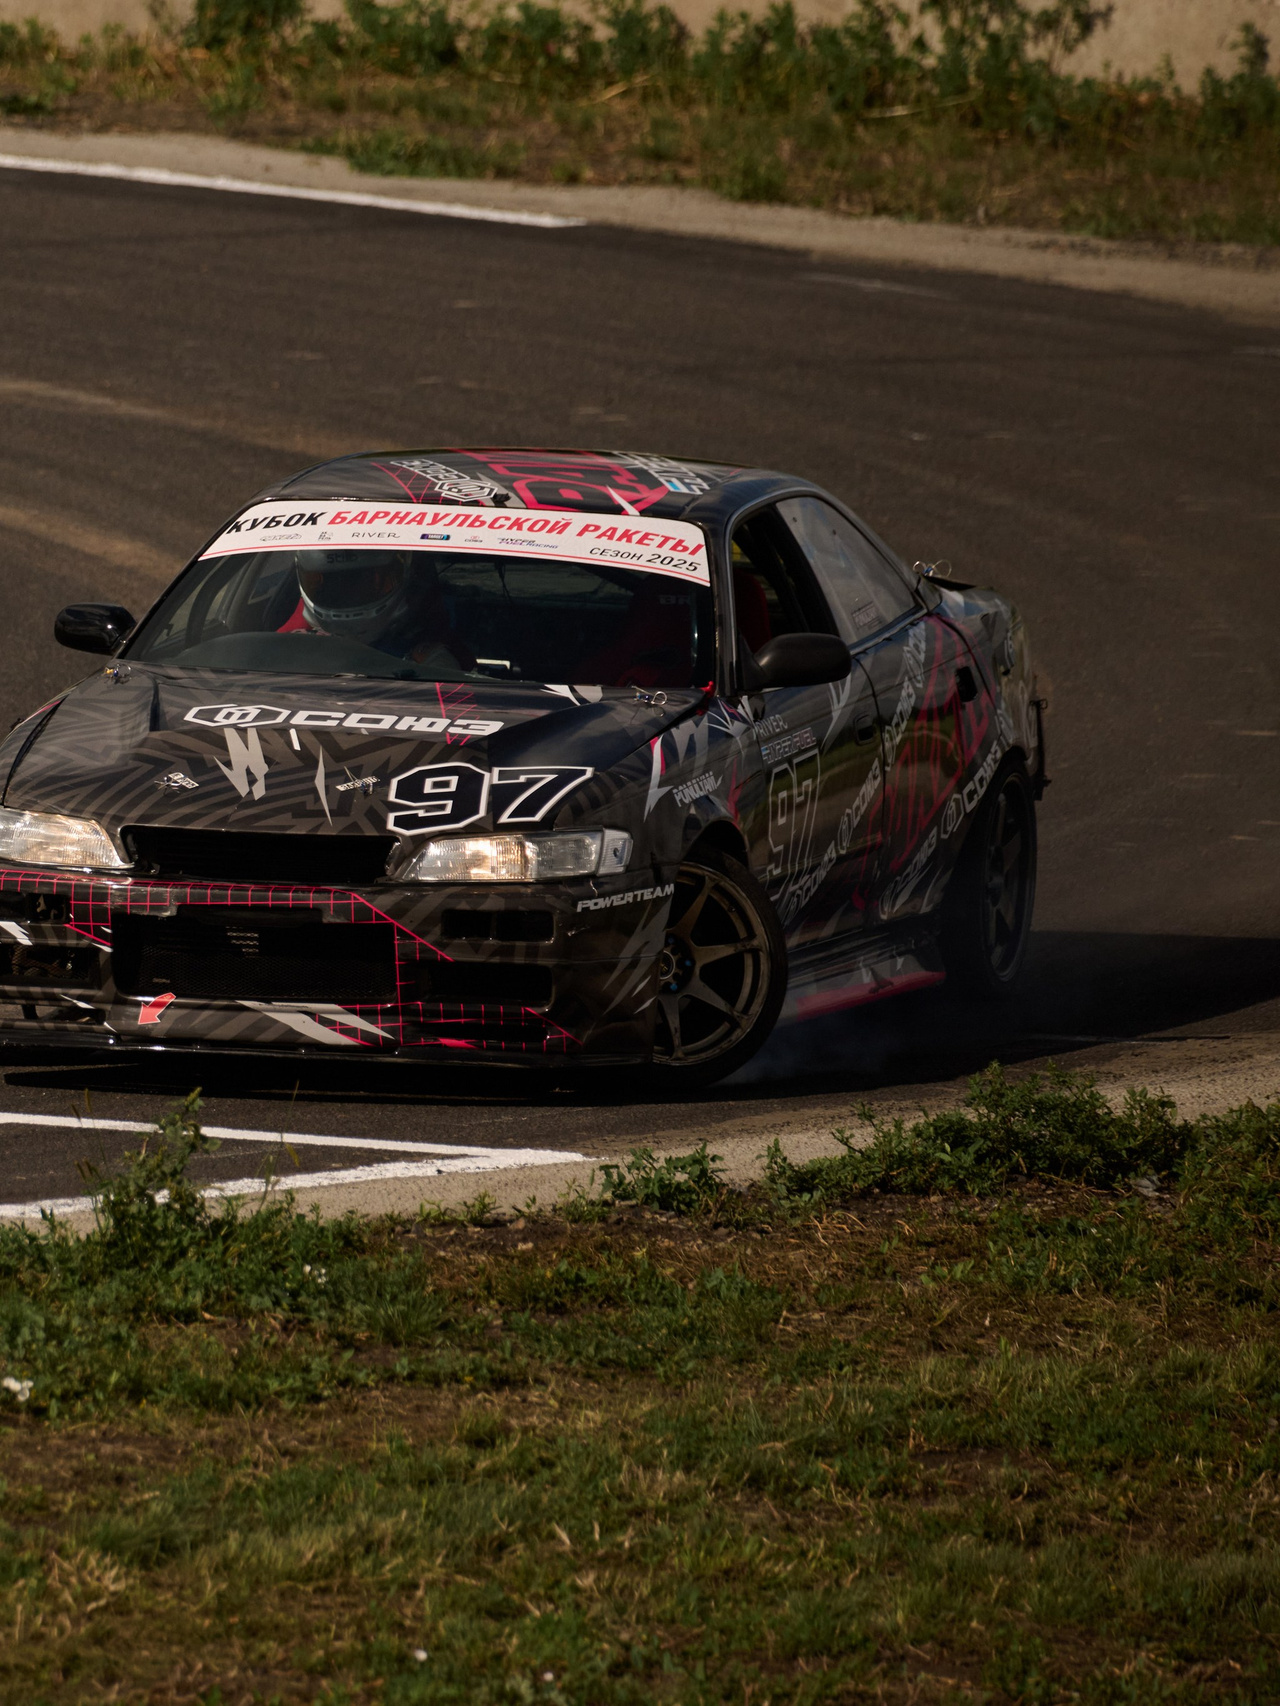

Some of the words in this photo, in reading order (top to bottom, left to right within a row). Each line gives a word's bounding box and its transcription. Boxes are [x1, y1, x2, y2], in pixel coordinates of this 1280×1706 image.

[226, 511, 327, 535] КУБОК
[328, 511, 572, 536] БАРНАУЛЬСКОЙ
[577, 523, 705, 556] РАКЕТЫ
[351, 532, 401, 540] RIVER
[589, 547, 644, 561] СЕЗОН
[646, 553, 702, 572] 2025
[289, 711, 504, 736] СОЮЗ
[386, 761, 596, 837] 97
[765, 748, 820, 902] 97
